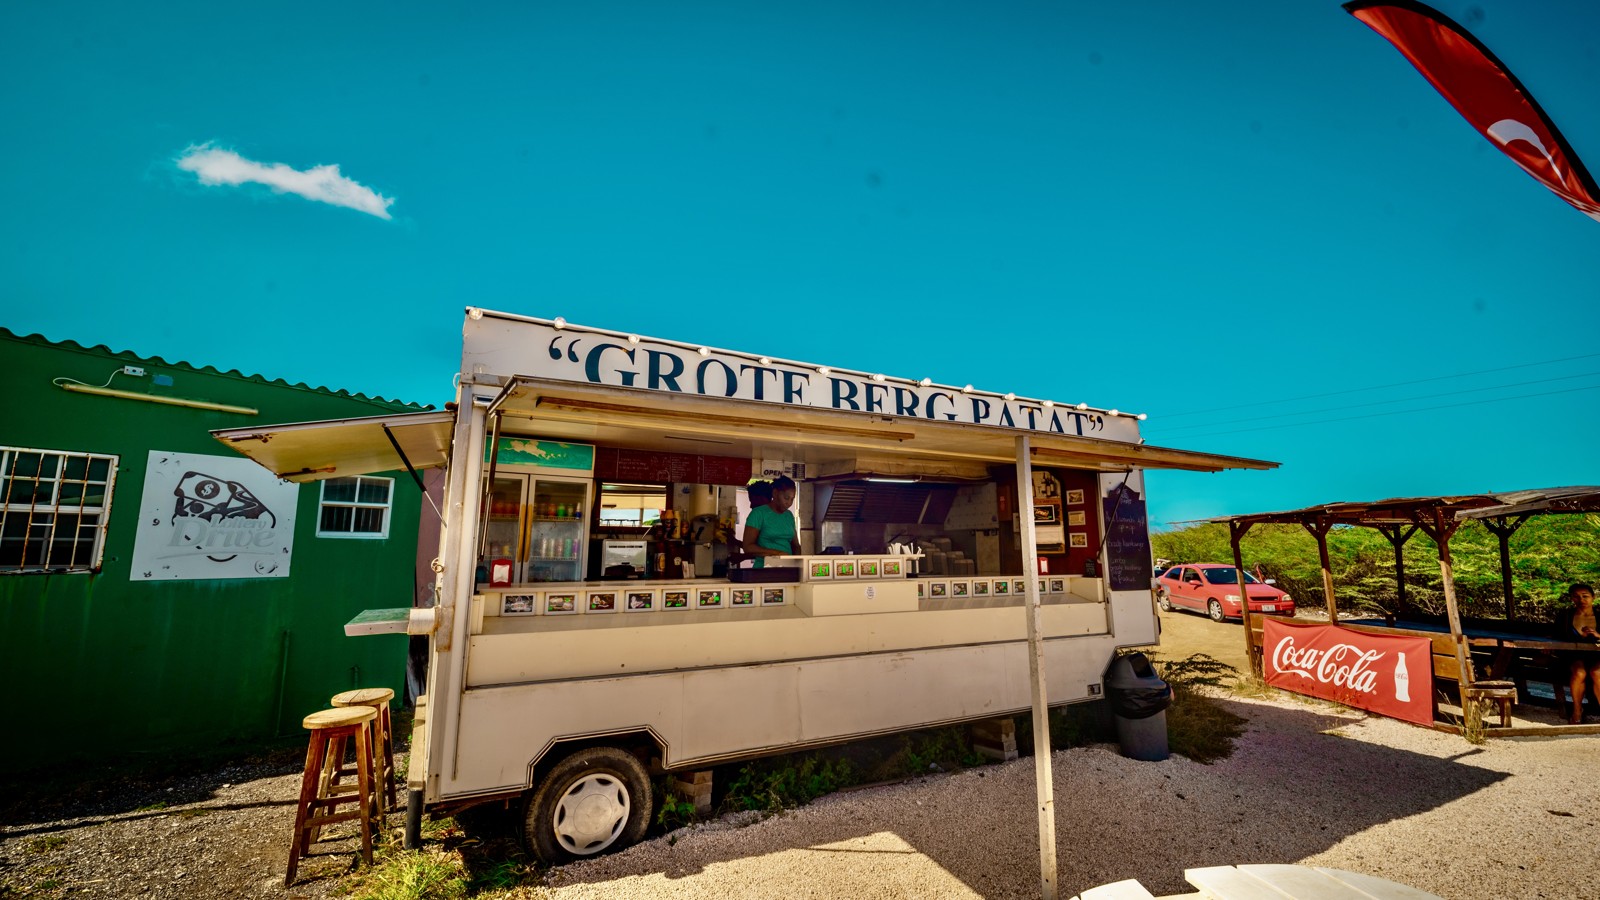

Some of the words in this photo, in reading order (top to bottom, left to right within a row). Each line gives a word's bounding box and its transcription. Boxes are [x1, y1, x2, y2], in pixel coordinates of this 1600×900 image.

[827, 376, 958, 420] BERG
[168, 517, 277, 548] Drive
[213, 517, 267, 530] Lottery
[1272, 636, 1386, 693] Coca-Cola
